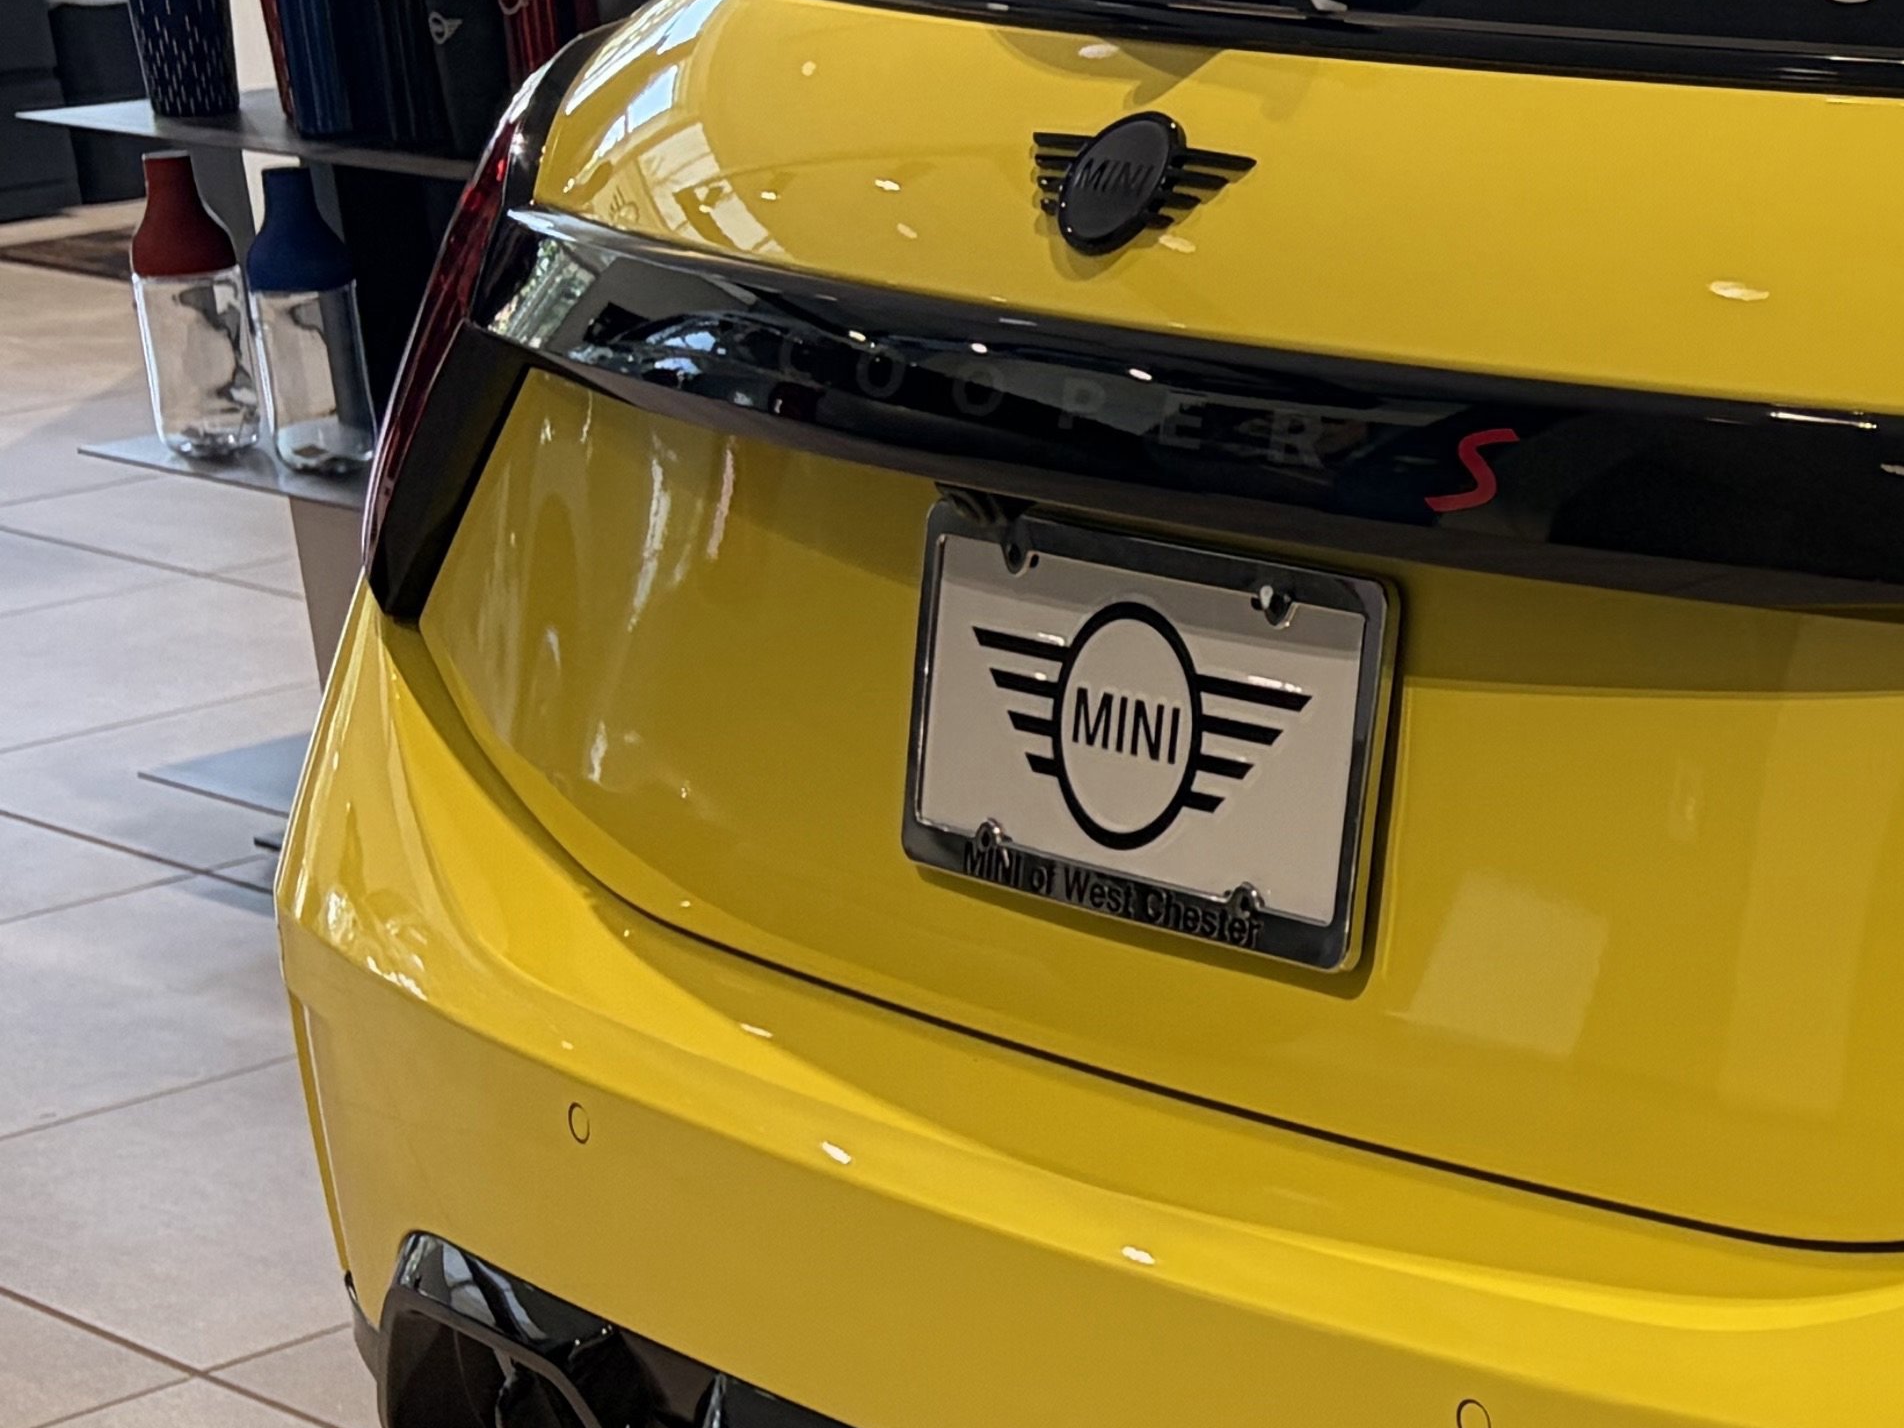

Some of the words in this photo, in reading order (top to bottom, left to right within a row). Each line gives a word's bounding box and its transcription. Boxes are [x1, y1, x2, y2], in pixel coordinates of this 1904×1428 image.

[1074, 158, 1154, 198] MINI
[781, 326, 1325, 468] COOPER
[1424, 427, 1520, 513] S
[1071, 686, 1181, 765] MINI
[963, 840, 1023, 887] MINI
[1031, 862, 1056, 894] of
[1063, 867, 1135, 916] West
[1144, 887, 1262, 949] Chester
